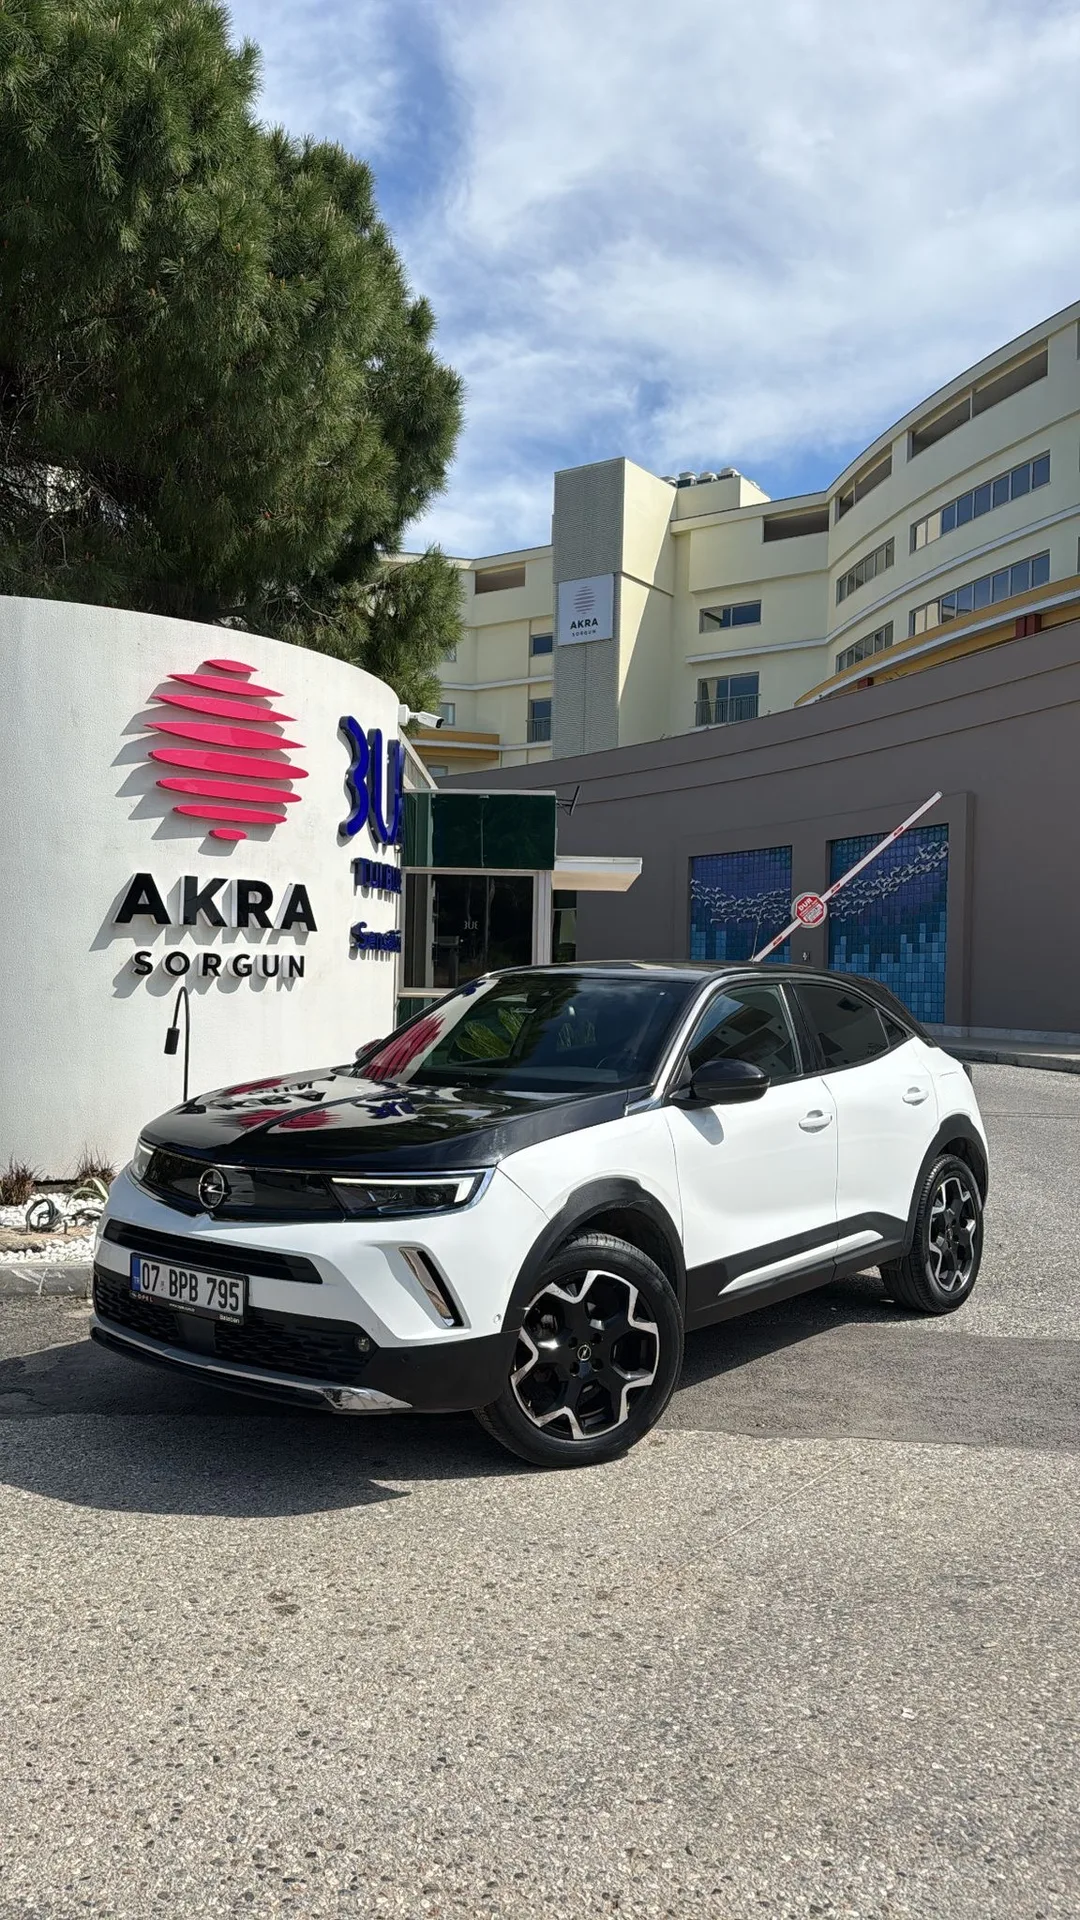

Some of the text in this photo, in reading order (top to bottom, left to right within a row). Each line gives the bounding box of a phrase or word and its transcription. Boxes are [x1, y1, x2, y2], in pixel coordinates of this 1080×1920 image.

[570, 618, 598, 629] AKRA
[114, 873, 318, 932] AKRA
[798, 897, 813, 911] DUR
[134, 951, 304, 978] SORGUN
[142, 1262, 240, 1312] 07 BPB 795
[138, 1294, 153, 1303] OPEL
